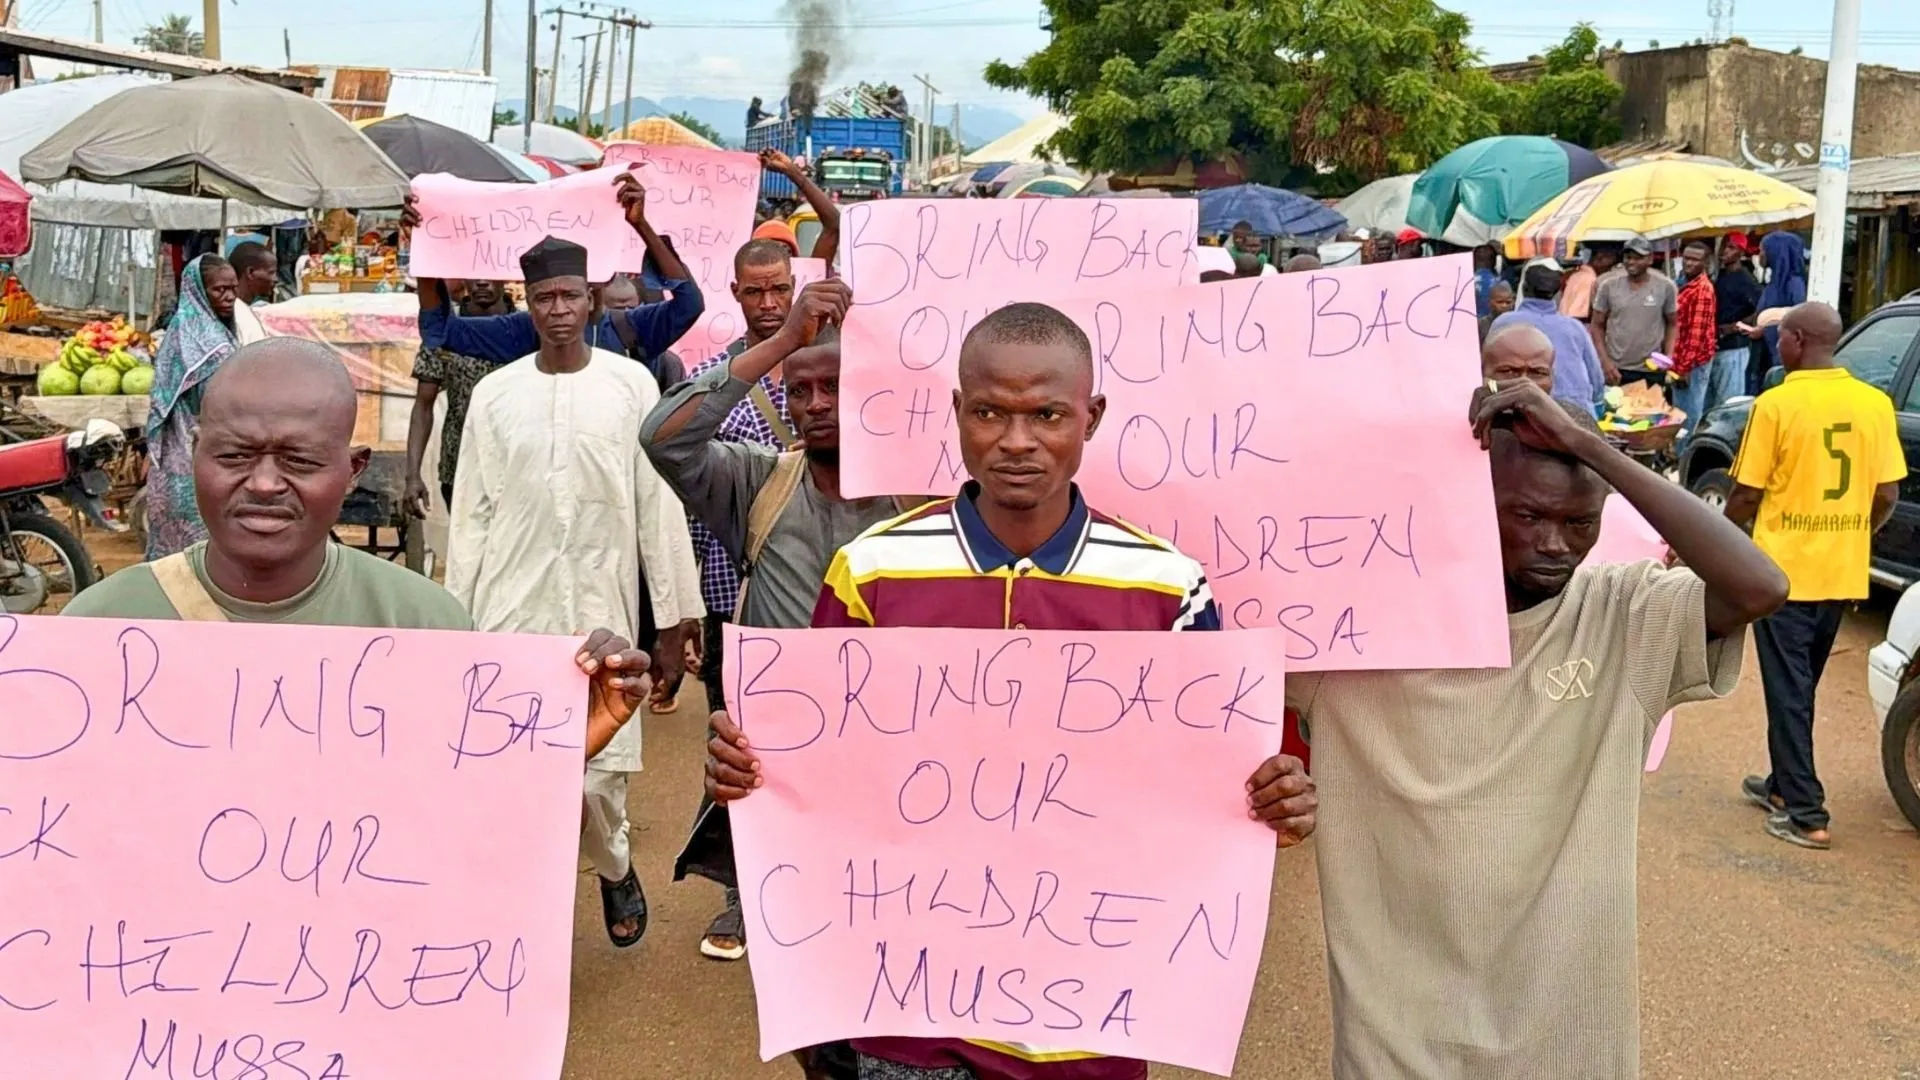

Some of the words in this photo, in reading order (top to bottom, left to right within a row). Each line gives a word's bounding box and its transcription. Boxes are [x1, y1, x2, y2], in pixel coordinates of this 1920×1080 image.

[645, 184, 714, 208] OUR
[716, 164, 756, 192] BACK
[425, 206, 594, 239] CHILDREN
[473, 239, 527, 272] MUS
[846, 200, 1048, 306] BRING
[1076, 200, 1198, 288] BACK
[1095, 280, 1267, 394] RING
[1307, 266, 1477, 358] BACK
[1118, 403, 1290, 491] OUR
[1822, 422, 1852, 502] 5
[1172, 504, 1421, 579] DREN
[1217, 598, 1368, 660] SSA
[739, 632, 1031, 751] BRING
[1057, 642, 1277, 733] BACK
[899, 754, 1097, 831] OUR
[198, 807, 430, 897] OUR
[760, 859, 1240, 963] CHILDREN
[0, 921, 526, 1016] CHILDREN
[864, 941, 1138, 1037] MUSSA
